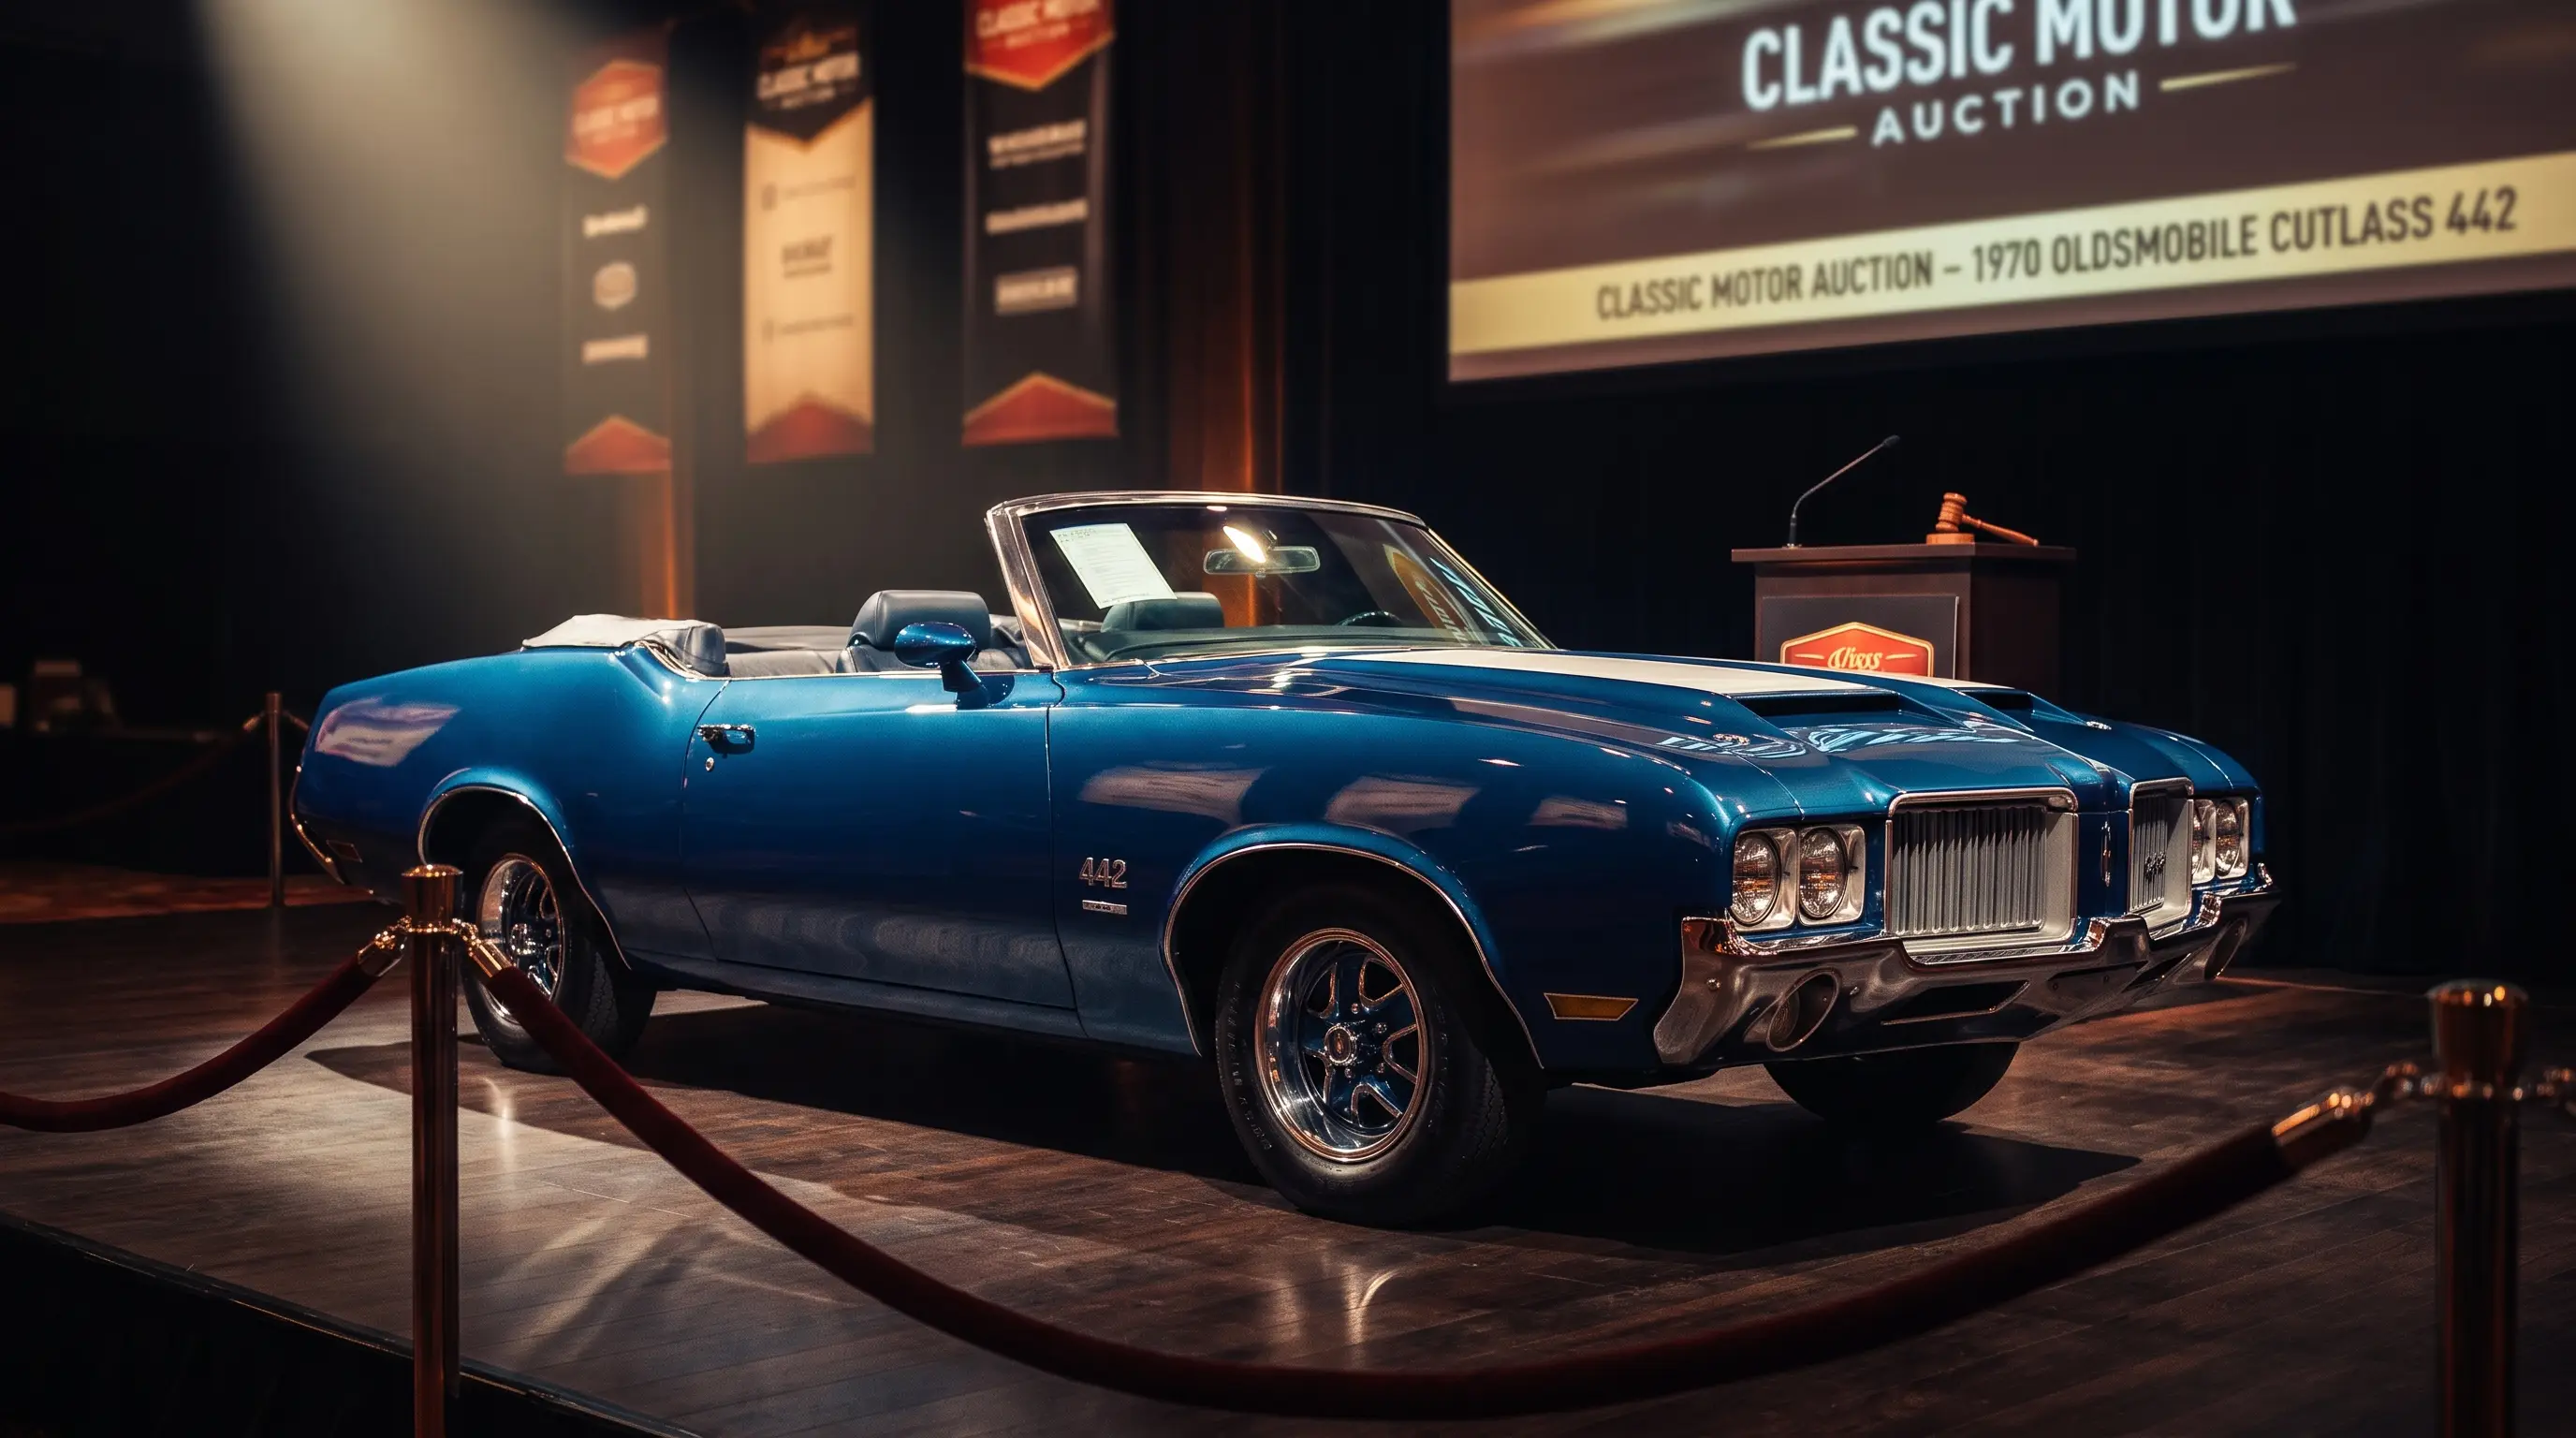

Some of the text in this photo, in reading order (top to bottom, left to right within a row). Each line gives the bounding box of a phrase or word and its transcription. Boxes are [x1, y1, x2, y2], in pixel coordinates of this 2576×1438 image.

[1742, 0, 2013, 110] CLASSIC
[1871, 69, 2139, 146] AUCTION
[1596, 275, 1702, 320] CLASSIC
[1711, 264, 1803, 308] MOTOR
[1811, 250, 1934, 300] AUCTION
[1972, 237, 2042, 282] 1970
[2052, 213, 2259, 275] OLDSMOBILE
[2270, 195, 2434, 253] CUTLASS
[2445, 184, 2518, 235] 442
[1079, 857, 1127, 888] 442
